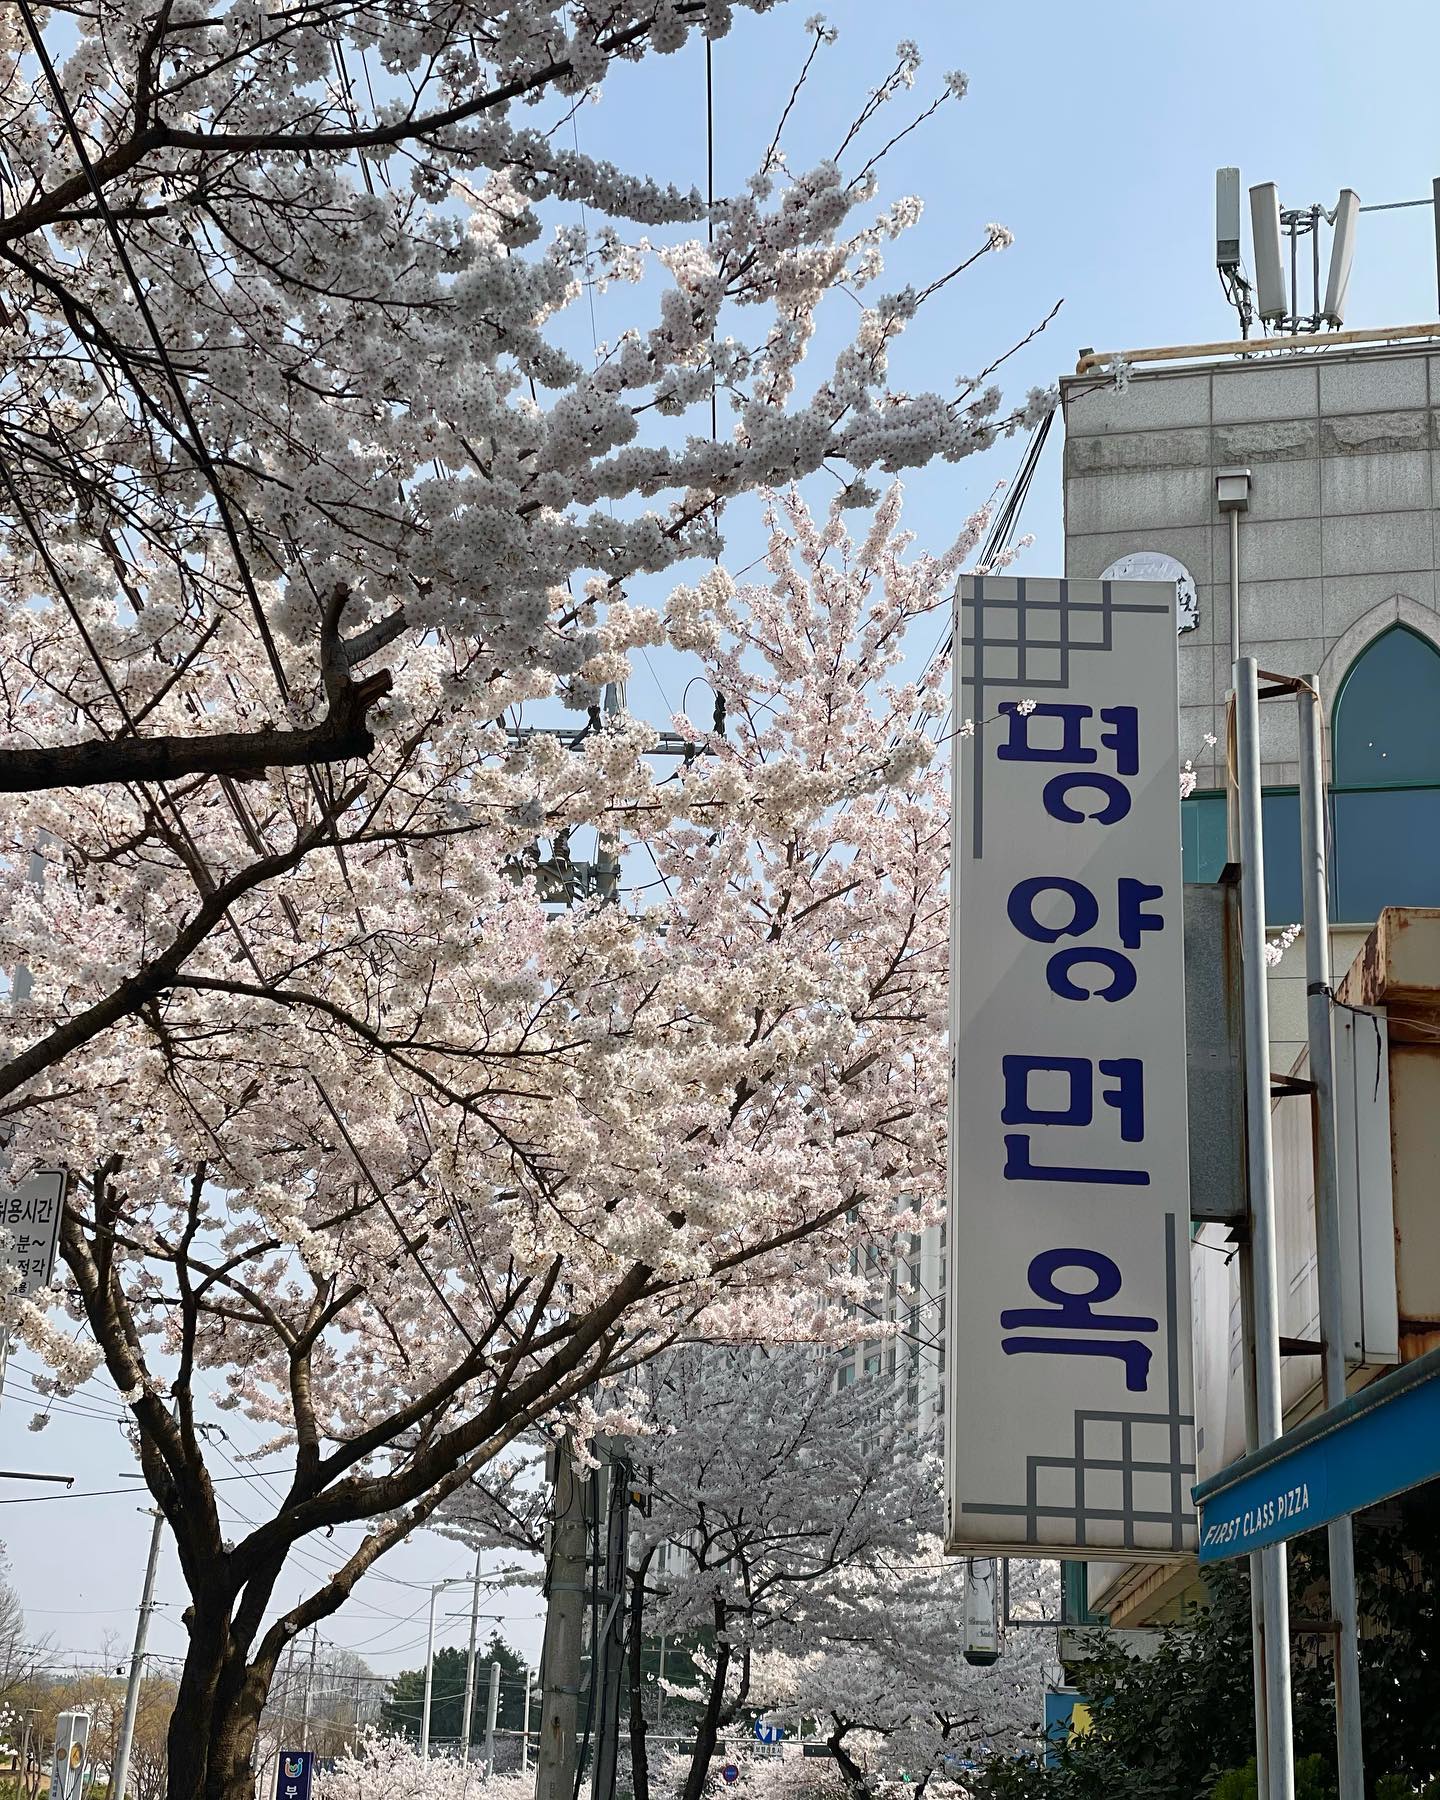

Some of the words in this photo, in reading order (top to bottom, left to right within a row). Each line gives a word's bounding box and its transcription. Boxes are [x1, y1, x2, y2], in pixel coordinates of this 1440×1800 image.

[997, 701, 1164, 1392] 평양면옥
[1203, 1516, 1241, 1547] FIRST
[1243, 1501, 1274, 1537] CLASS
[1277, 1483, 1309, 1522] PIZZA
[284, 1785, 298, 1800] 부
